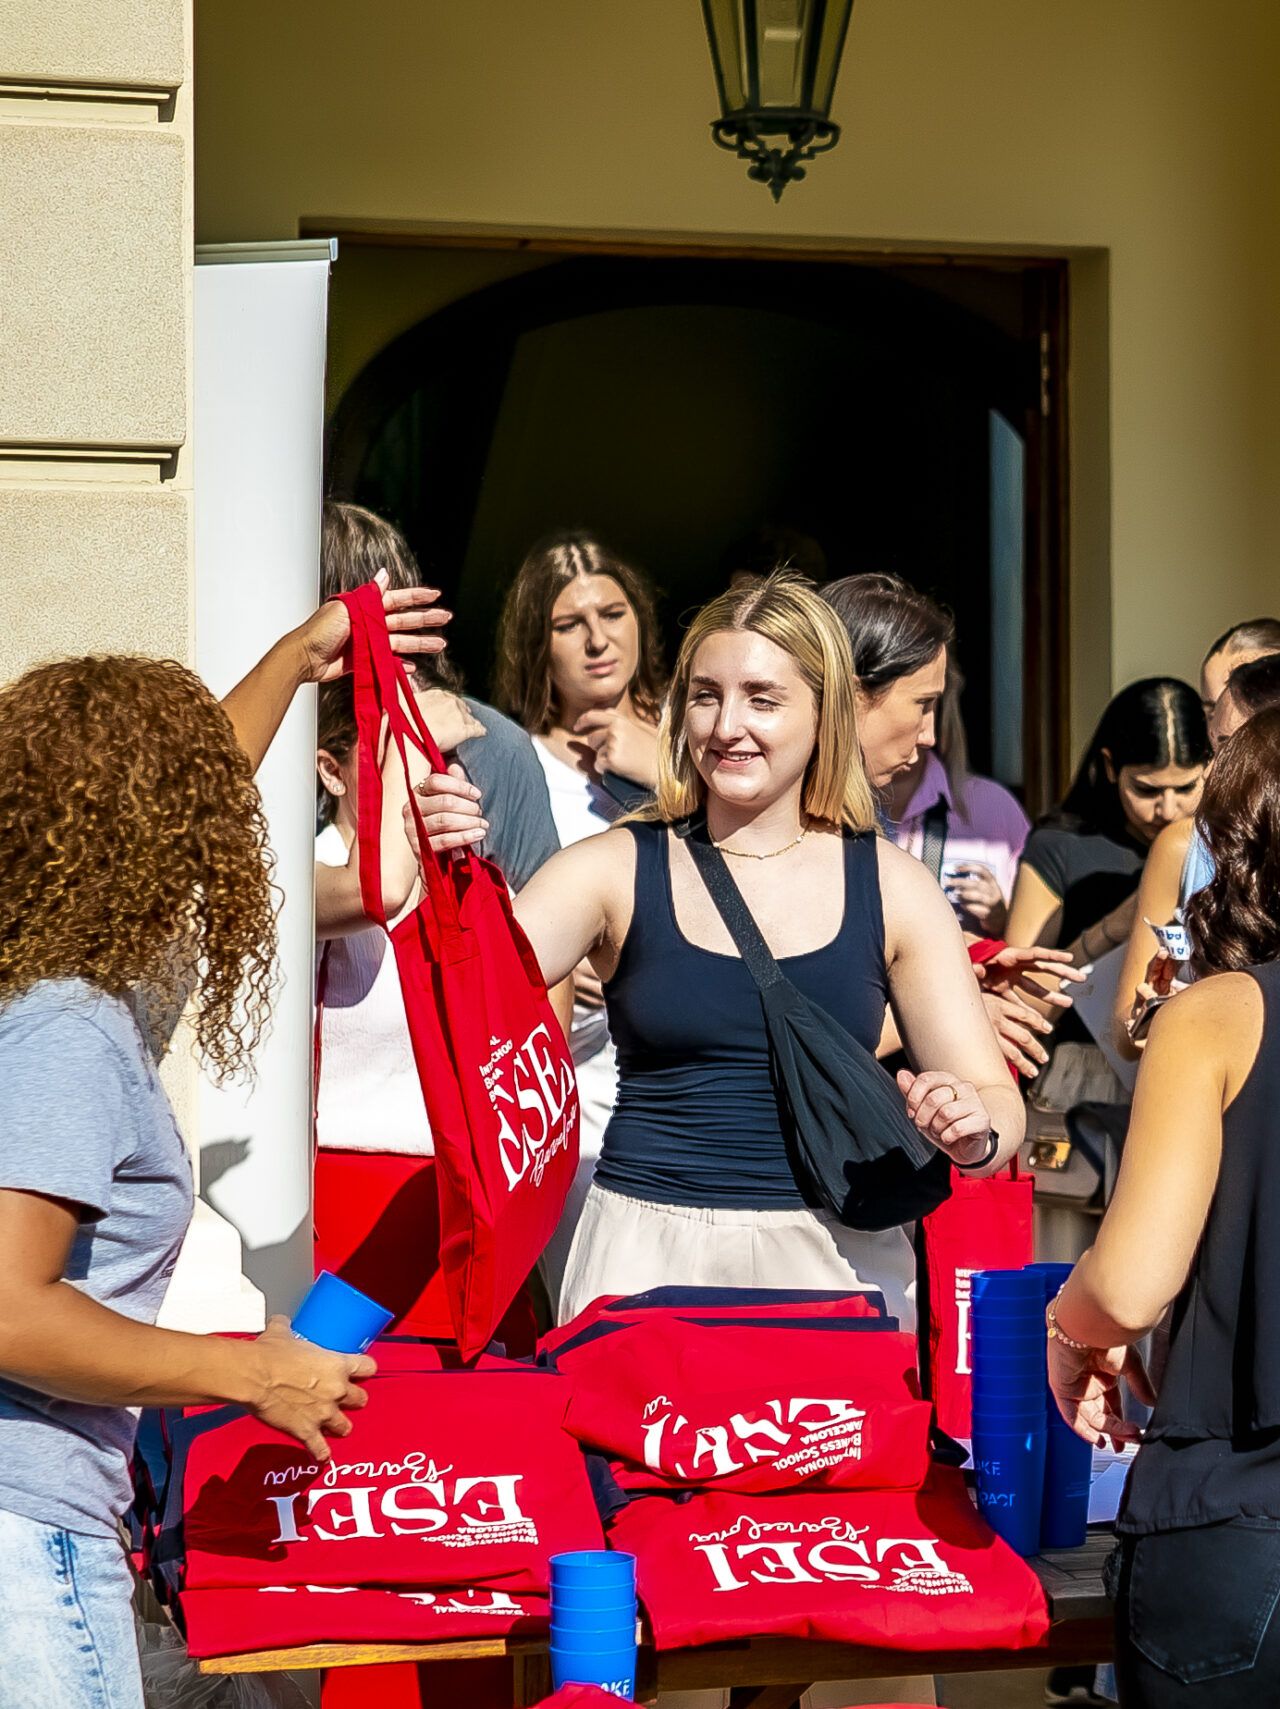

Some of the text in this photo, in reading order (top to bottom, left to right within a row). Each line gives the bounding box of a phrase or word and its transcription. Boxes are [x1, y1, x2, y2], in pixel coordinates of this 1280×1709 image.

[264, 1452, 453, 1486] Barcelona
[772, 1444, 820, 1471] SCHOOL
[266, 1474, 533, 1543] ESEI
[689, 1515, 870, 1541] Barcelona
[694, 1539, 949, 1592] ESEI
